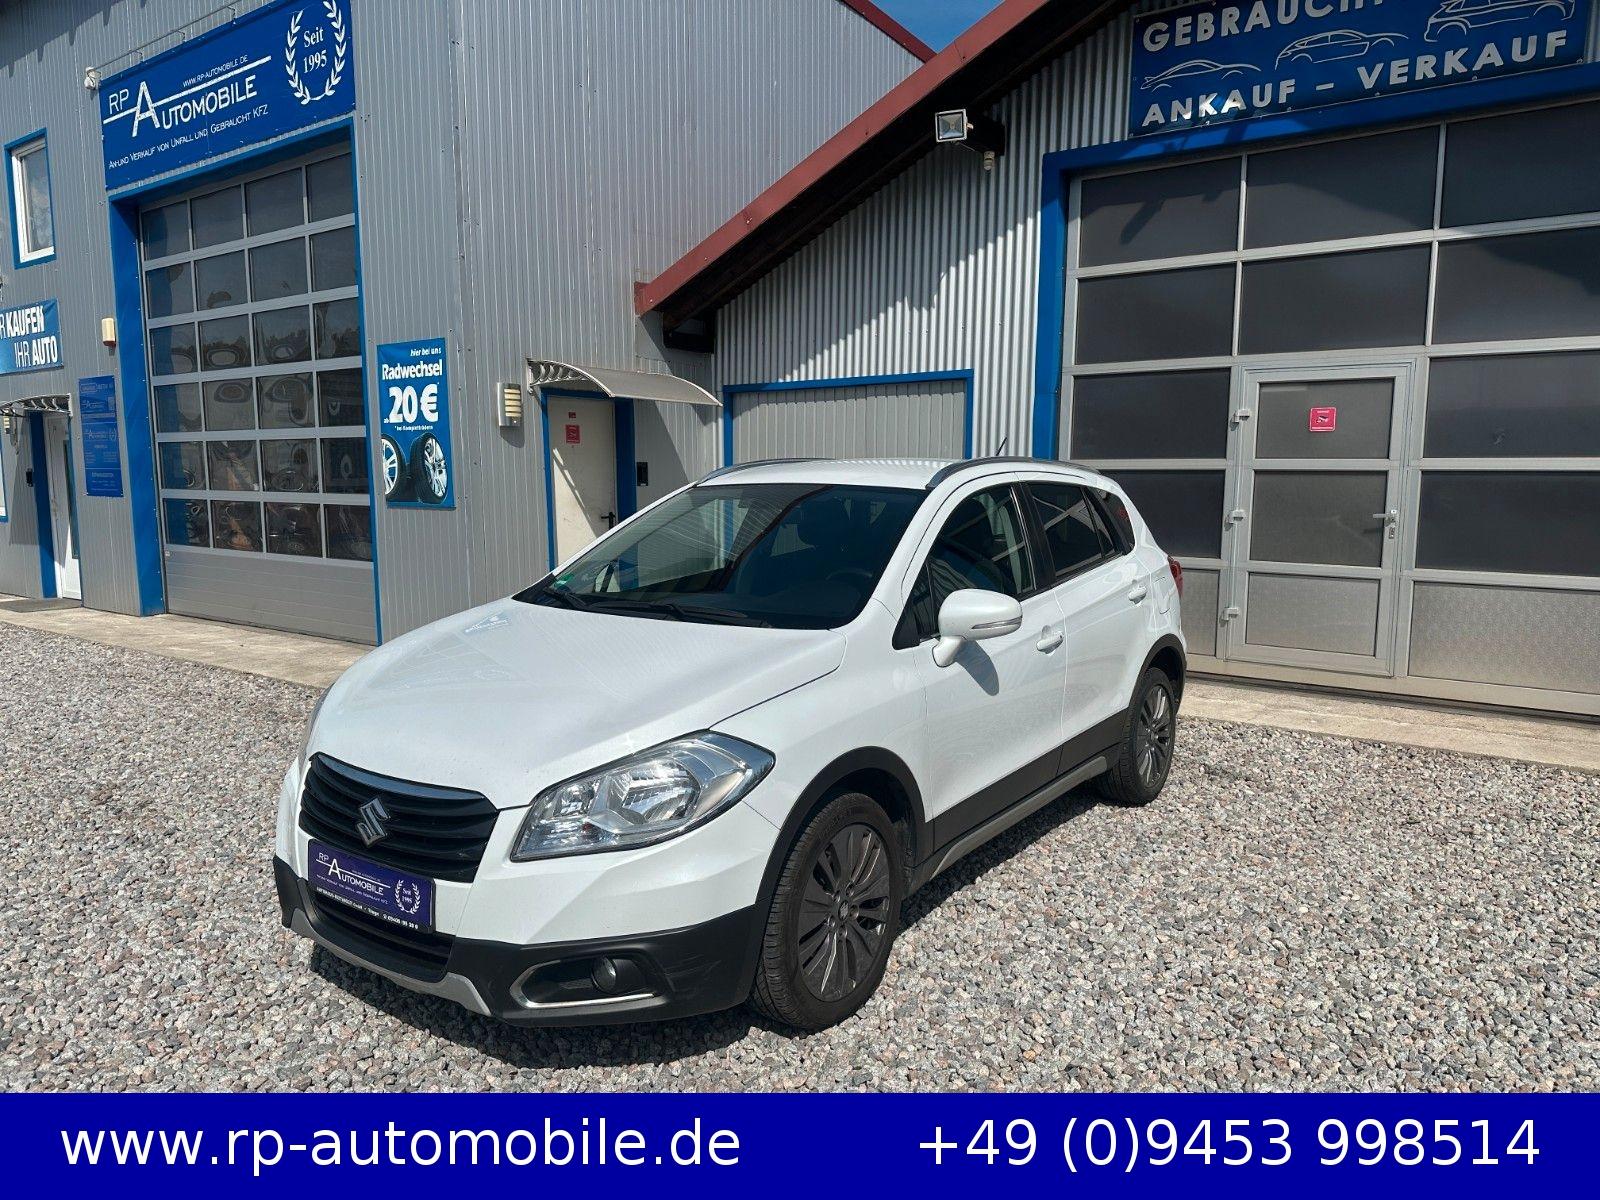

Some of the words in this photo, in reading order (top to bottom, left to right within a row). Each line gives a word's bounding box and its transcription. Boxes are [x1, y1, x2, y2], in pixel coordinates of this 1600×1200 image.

[303, 26, 324, 48] Seit
[303, 50, 328, 74] 1995
[1141, 79, 1297, 127] ANKAUF
[1357, 30, 1568, 90] VERKAUF
[109, 88, 129, 115] RP
[131, 74, 258, 138] AUTOMOBILE
[6, 305, 45, 338] KAUFEN
[14, 340, 31, 368] IHR
[32, 335, 58, 366] AUTO
[410, 348, 421, 357] hier
[430, 347, 442, 355] uns
[381, 358, 443, 381] Radwechsel
